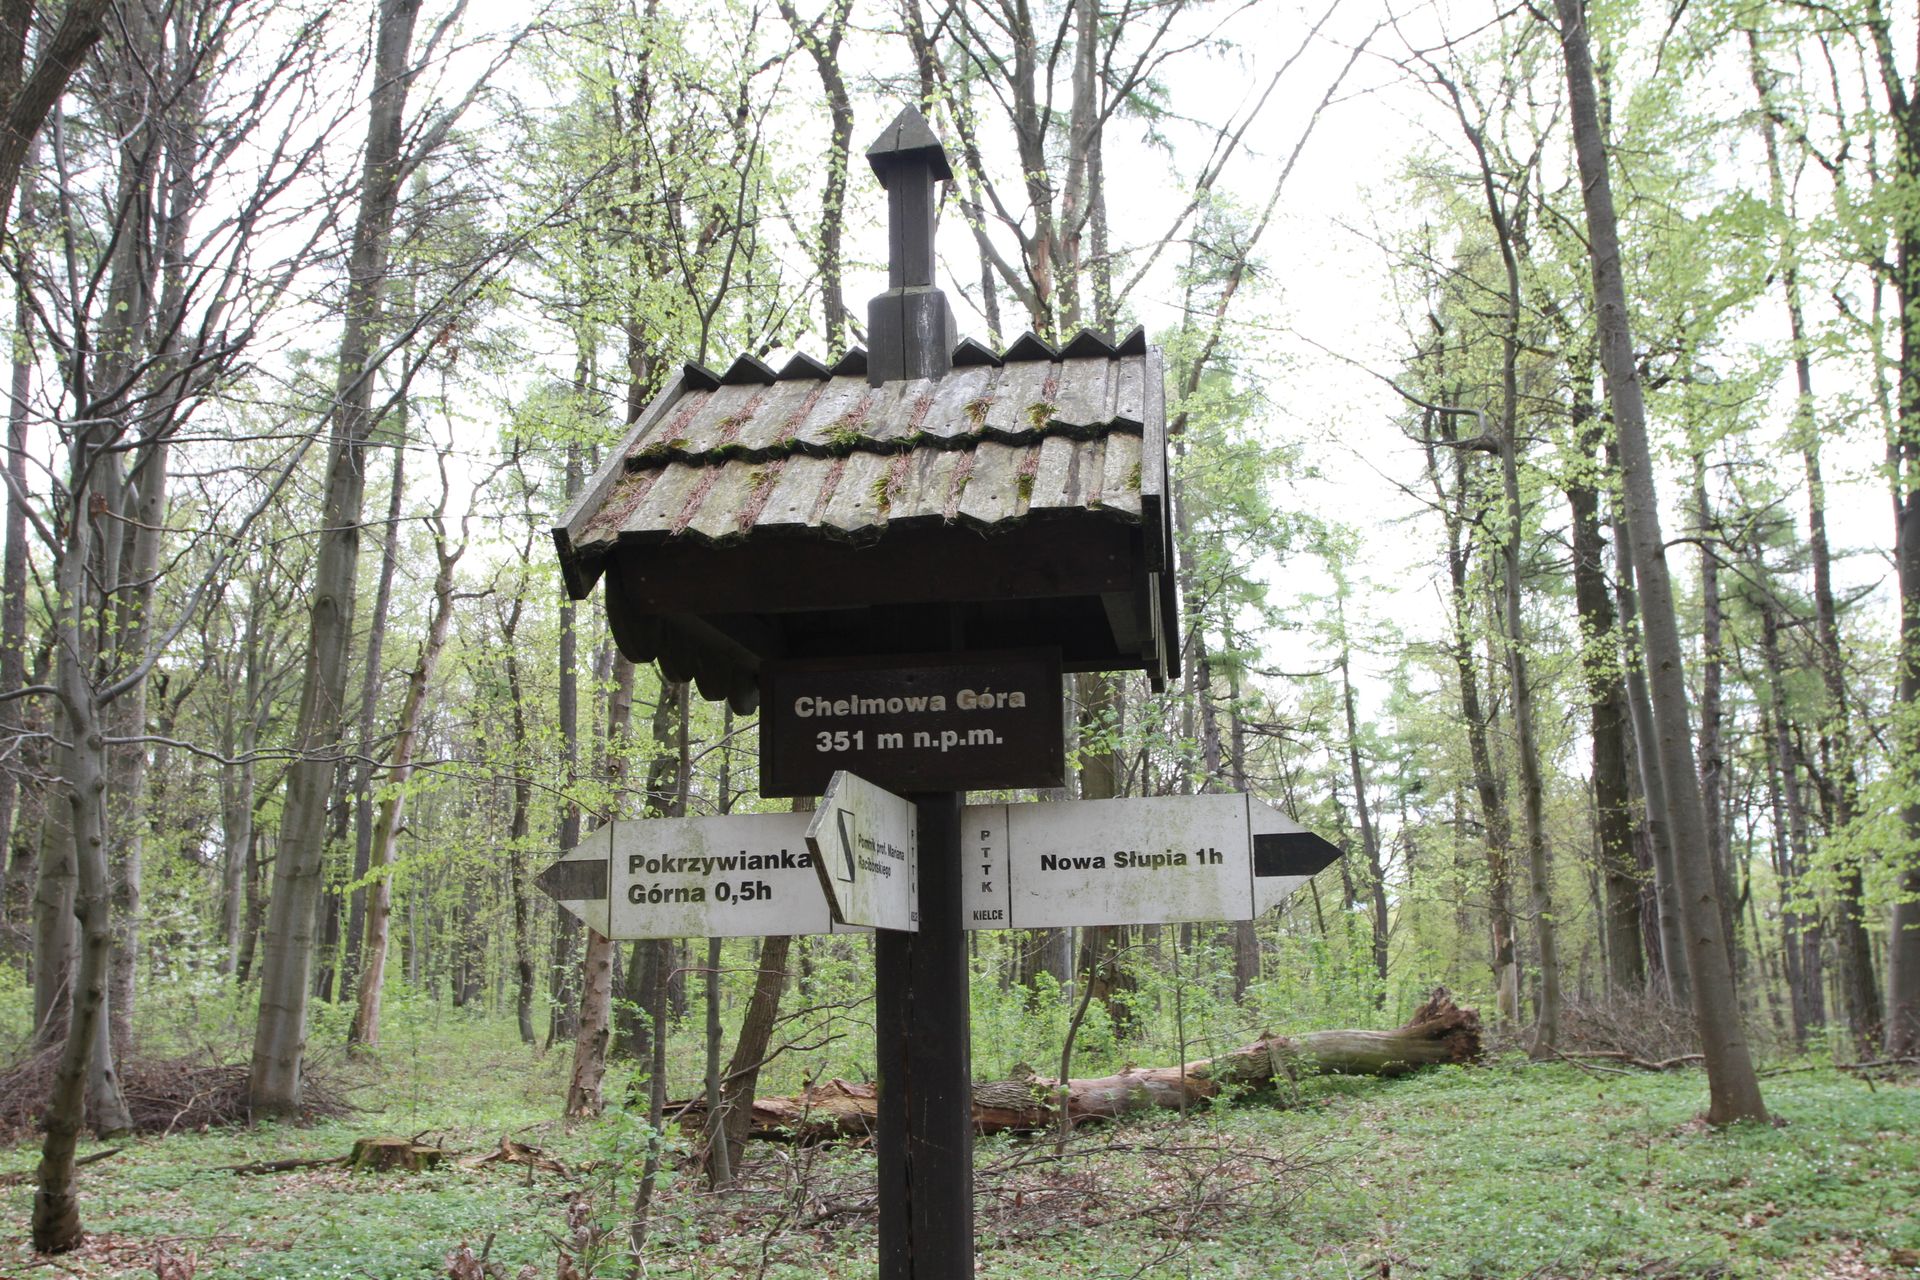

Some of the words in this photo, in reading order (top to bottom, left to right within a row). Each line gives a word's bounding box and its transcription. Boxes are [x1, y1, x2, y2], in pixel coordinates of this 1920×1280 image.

[794, 695, 947, 718] Chełmowa
[956, 687, 1026, 710] Góra
[816, 730, 864, 752] 351
[877, 732, 904, 749] m
[914, 728, 1004, 752] n.p.m.
[858, 833, 876, 851] Pomnik
[876, 842, 887, 856] prof.
[887, 843, 905, 861] Mariana
[1040, 852, 1106, 871] Nowa
[1113, 848, 1187, 870] Słupia
[1195, 847, 1224, 865] 1h
[628, 849, 813, 876] Pokrzywianka
[628, 883, 706, 904] Górna
[715, 880, 772, 905] 0,5h
[973, 909, 1003, 921] KIELCE
